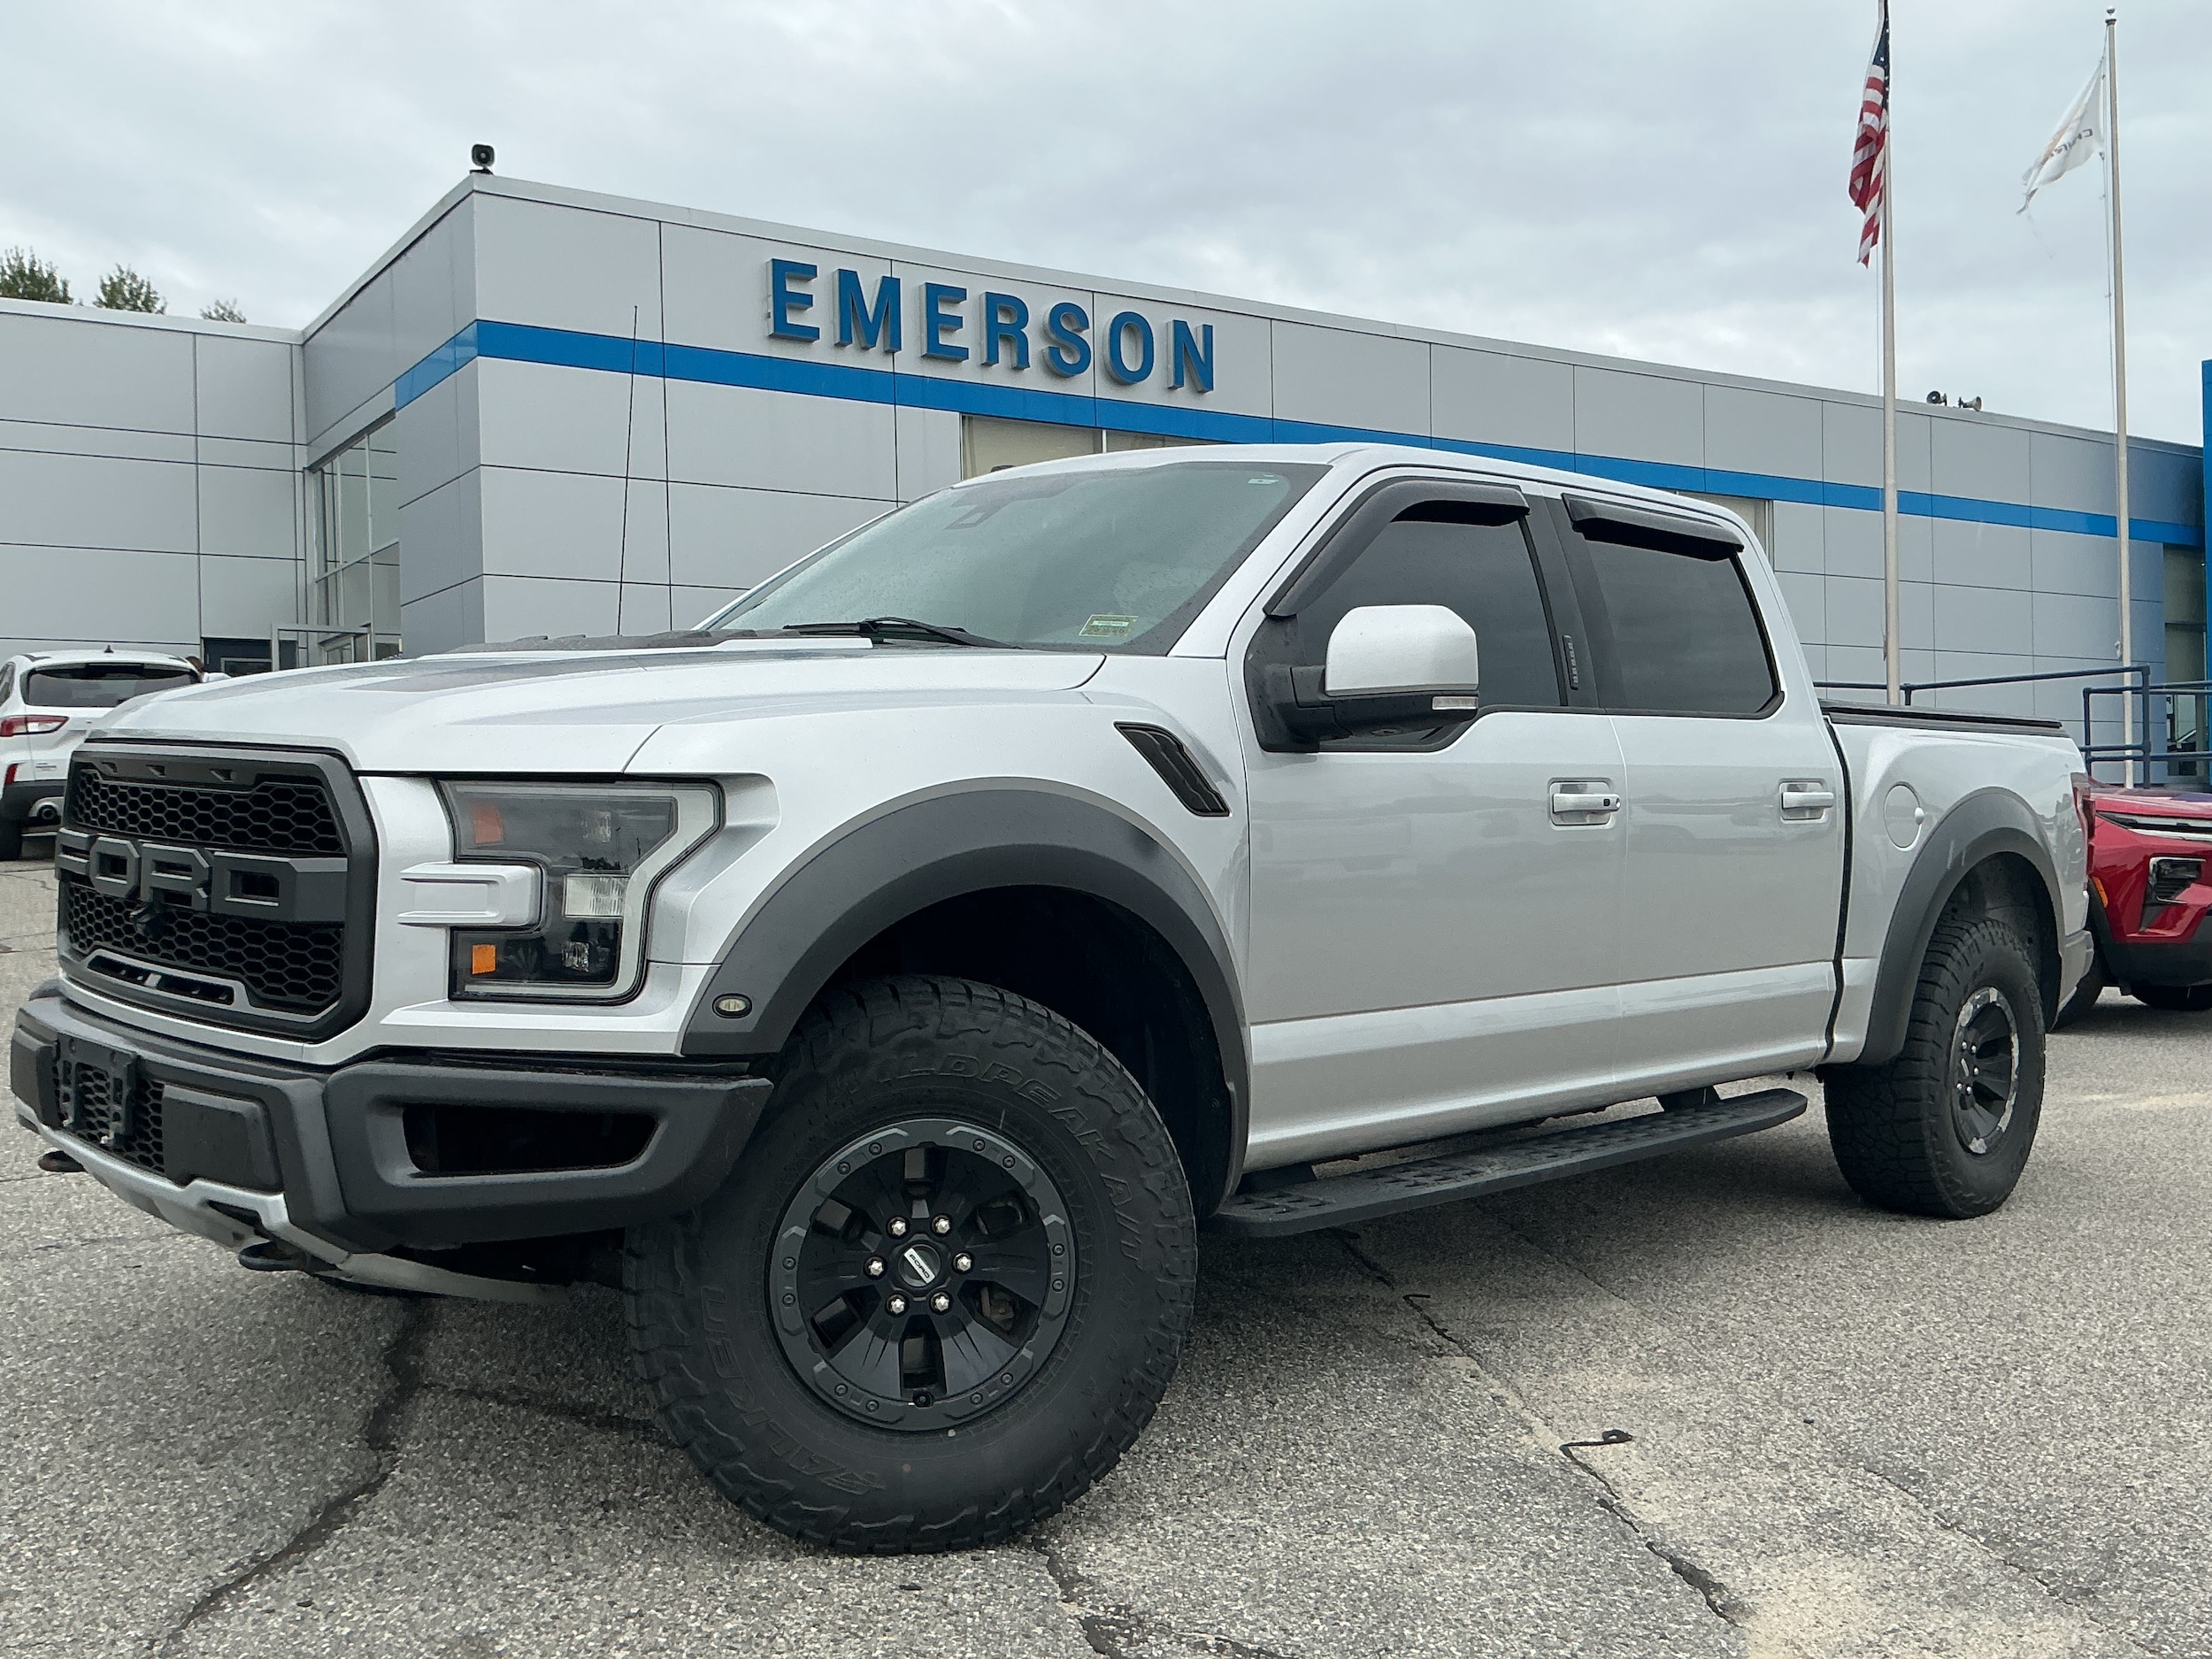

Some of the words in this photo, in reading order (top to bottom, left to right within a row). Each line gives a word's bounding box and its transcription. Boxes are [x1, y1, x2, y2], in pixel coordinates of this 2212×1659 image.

[768, 257, 1214, 393] EMERSON
[55, 827, 296, 922] FORD
[908, 1253, 931, 1279] FORD
